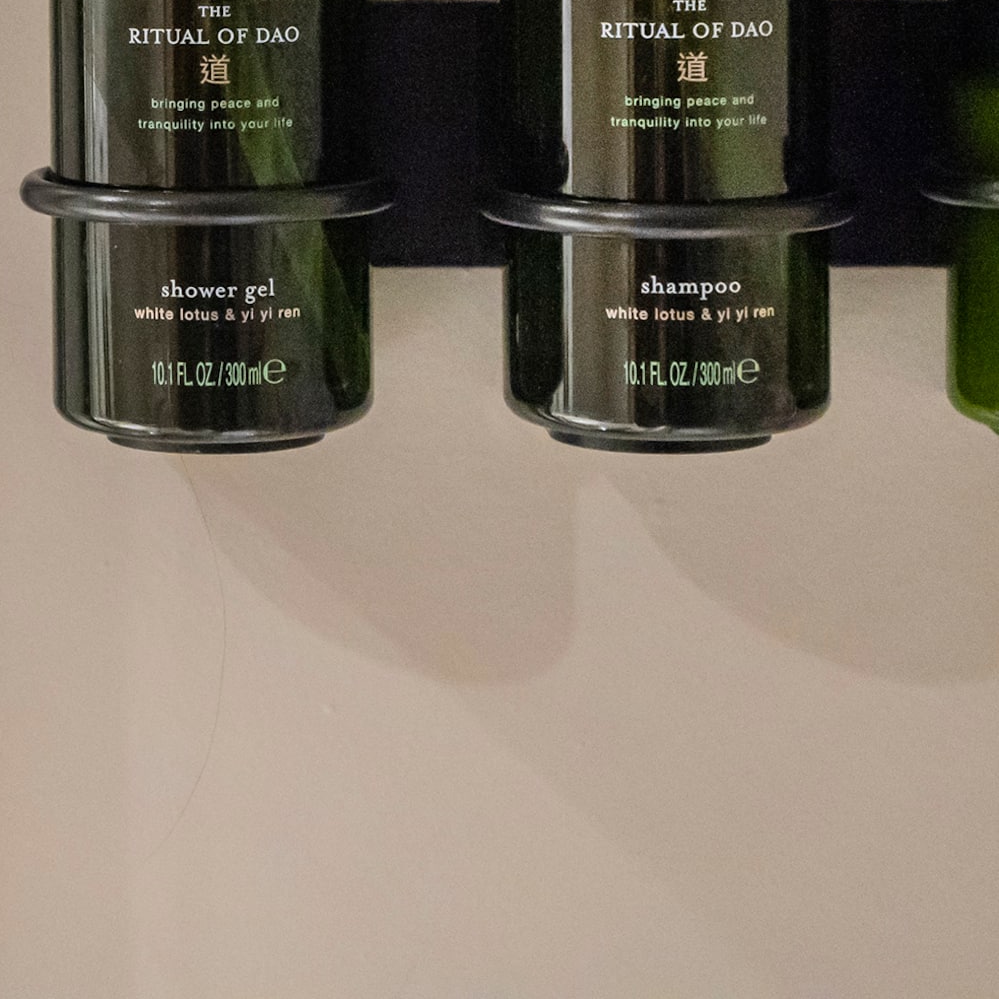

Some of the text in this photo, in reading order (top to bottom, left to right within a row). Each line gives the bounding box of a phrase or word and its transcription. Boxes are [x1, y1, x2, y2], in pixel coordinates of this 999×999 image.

[198, 5, 231, 18] THE
[672, 0, 707, 12] THE
[128, 26, 300, 45] RITUAL OF DAO
[600, 20, 774, 39] RITUAL OF DAO
[200, 54, 231, 86] 道
[676, 51, 709, 83] 道
[151, 96, 280, 112] bringing peace and
[624, 94, 755, 110] bringing peace and
[138, 117, 294, 133] tranquility into your life
[610, 114, 768, 131] tranquility into your life
[161, 278, 276, 305] shower gel
[640, 275, 742, 300] shampoo
[134, 306, 301, 323] white lotus & yi yi ren
[605, 305, 775, 323] white lotus & yi yi ren
[152, 361, 173, 386] 10.1
[624, 361, 646, 386] 10.1
